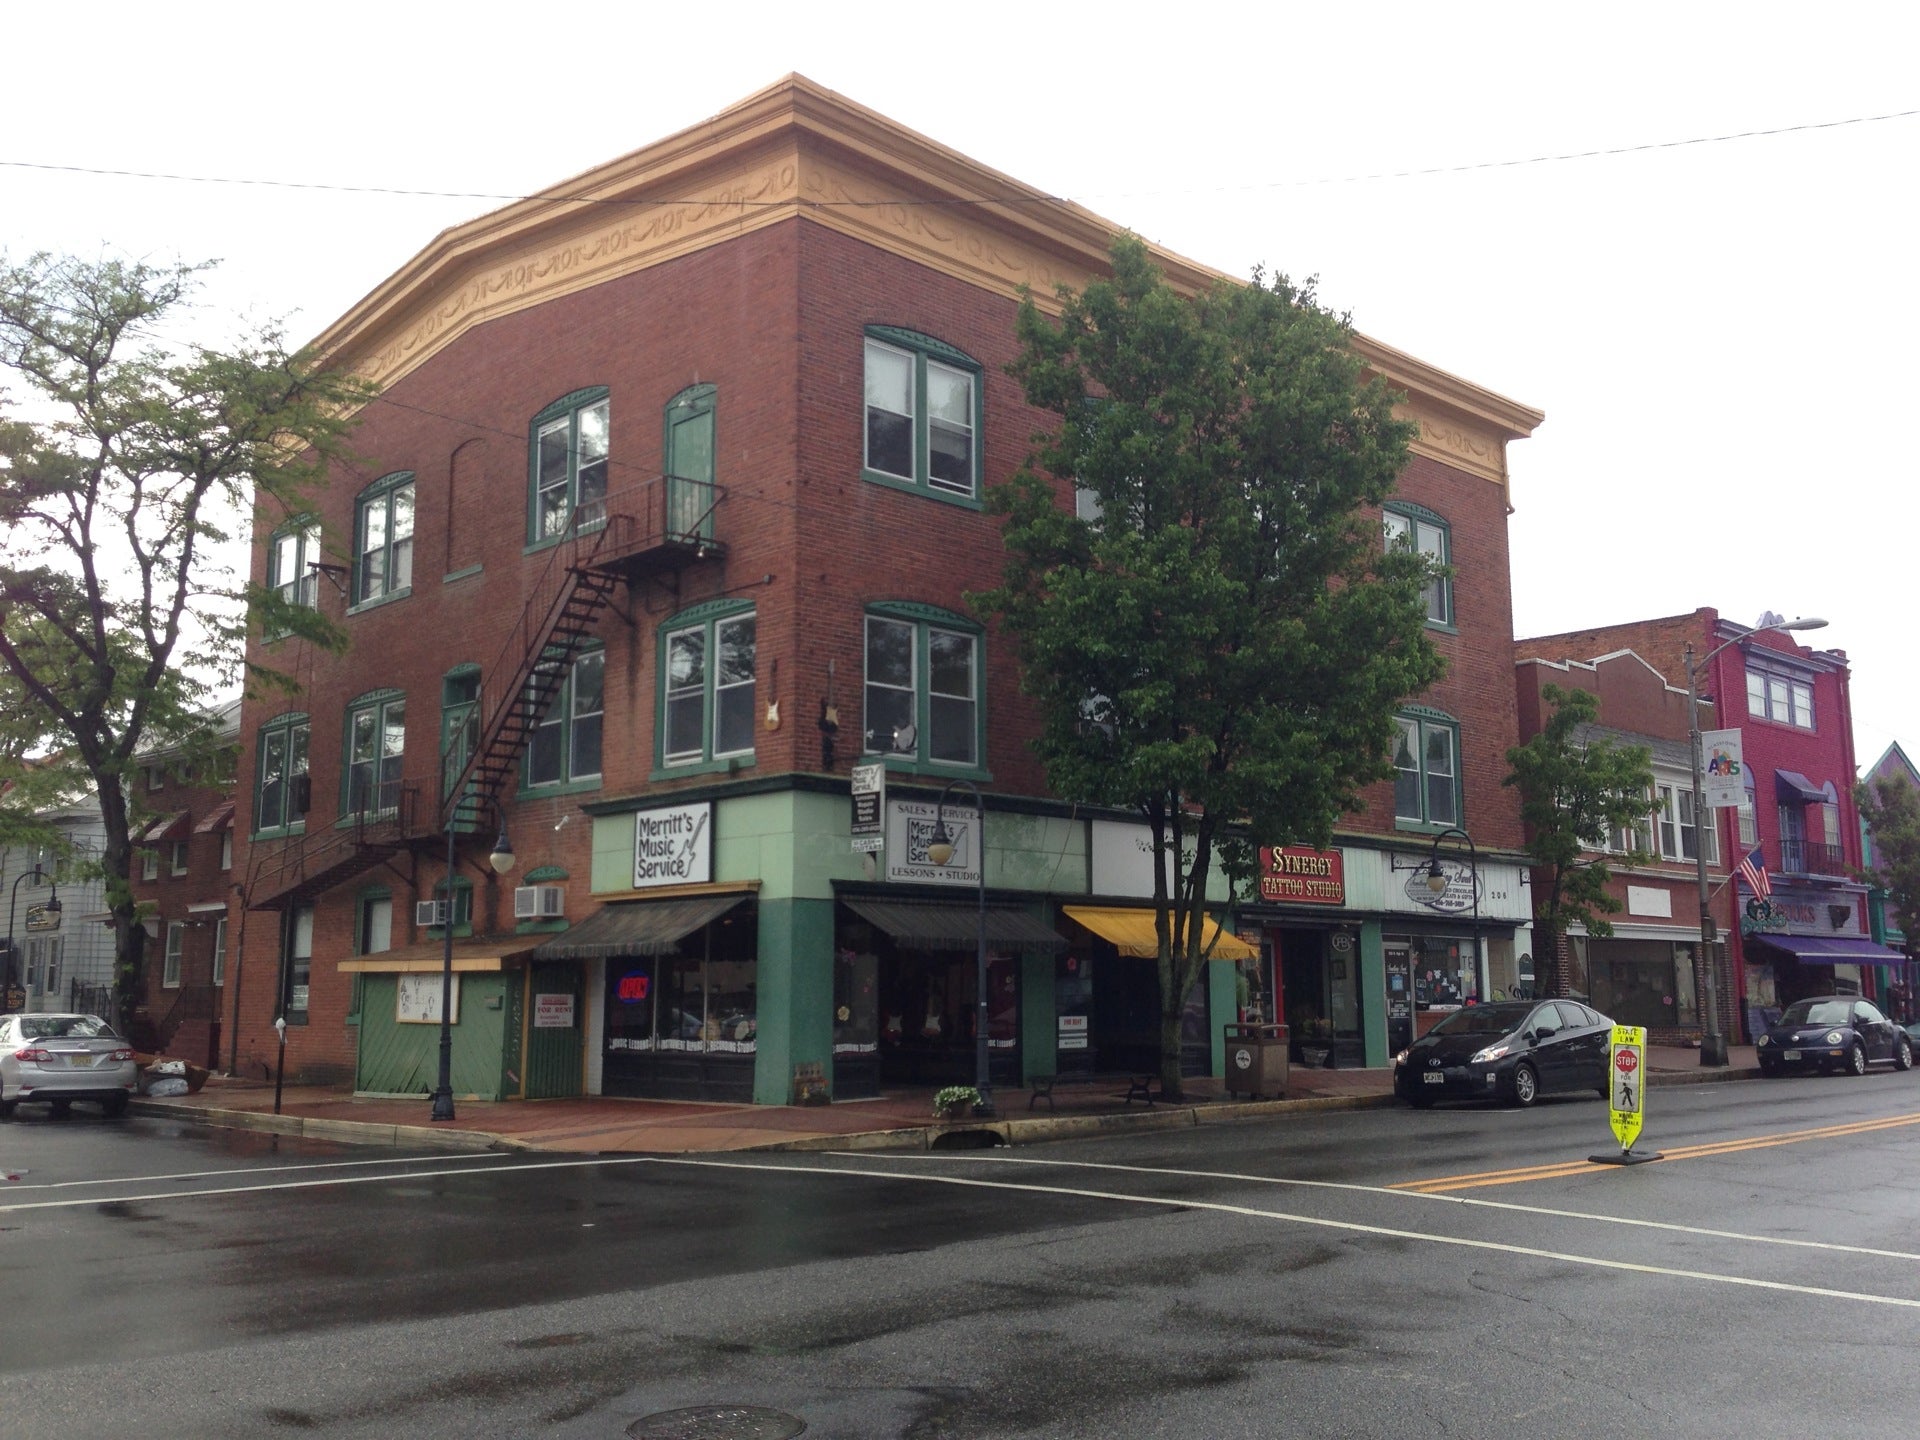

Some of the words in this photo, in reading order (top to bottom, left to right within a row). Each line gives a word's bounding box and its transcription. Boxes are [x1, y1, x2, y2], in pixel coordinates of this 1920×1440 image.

[1708, 759, 1740, 777] ARTS
[898, 804, 927, 816] SALES
[640, 812, 694, 837] Merritt's
[639, 835, 675, 858] Music
[638, 857, 685, 879] Service
[1272, 846, 1333, 876] SYNERGY
[891, 867, 936, 879] LESSONS
[946, 871, 980, 881] STUDIO
[1263, 877, 1303, 896] TATTOO
[1306, 880, 1342, 898] STUDIO
[1491, 891, 1507, 900] 206
[619, 977, 649, 999] OPEN
[537, 1006, 552, 1014] FOR
[555, 1006, 572, 1014] RENT
[1617, 1027, 1639, 1037] STATE
[1616, 1055, 1637, 1067] STOP
